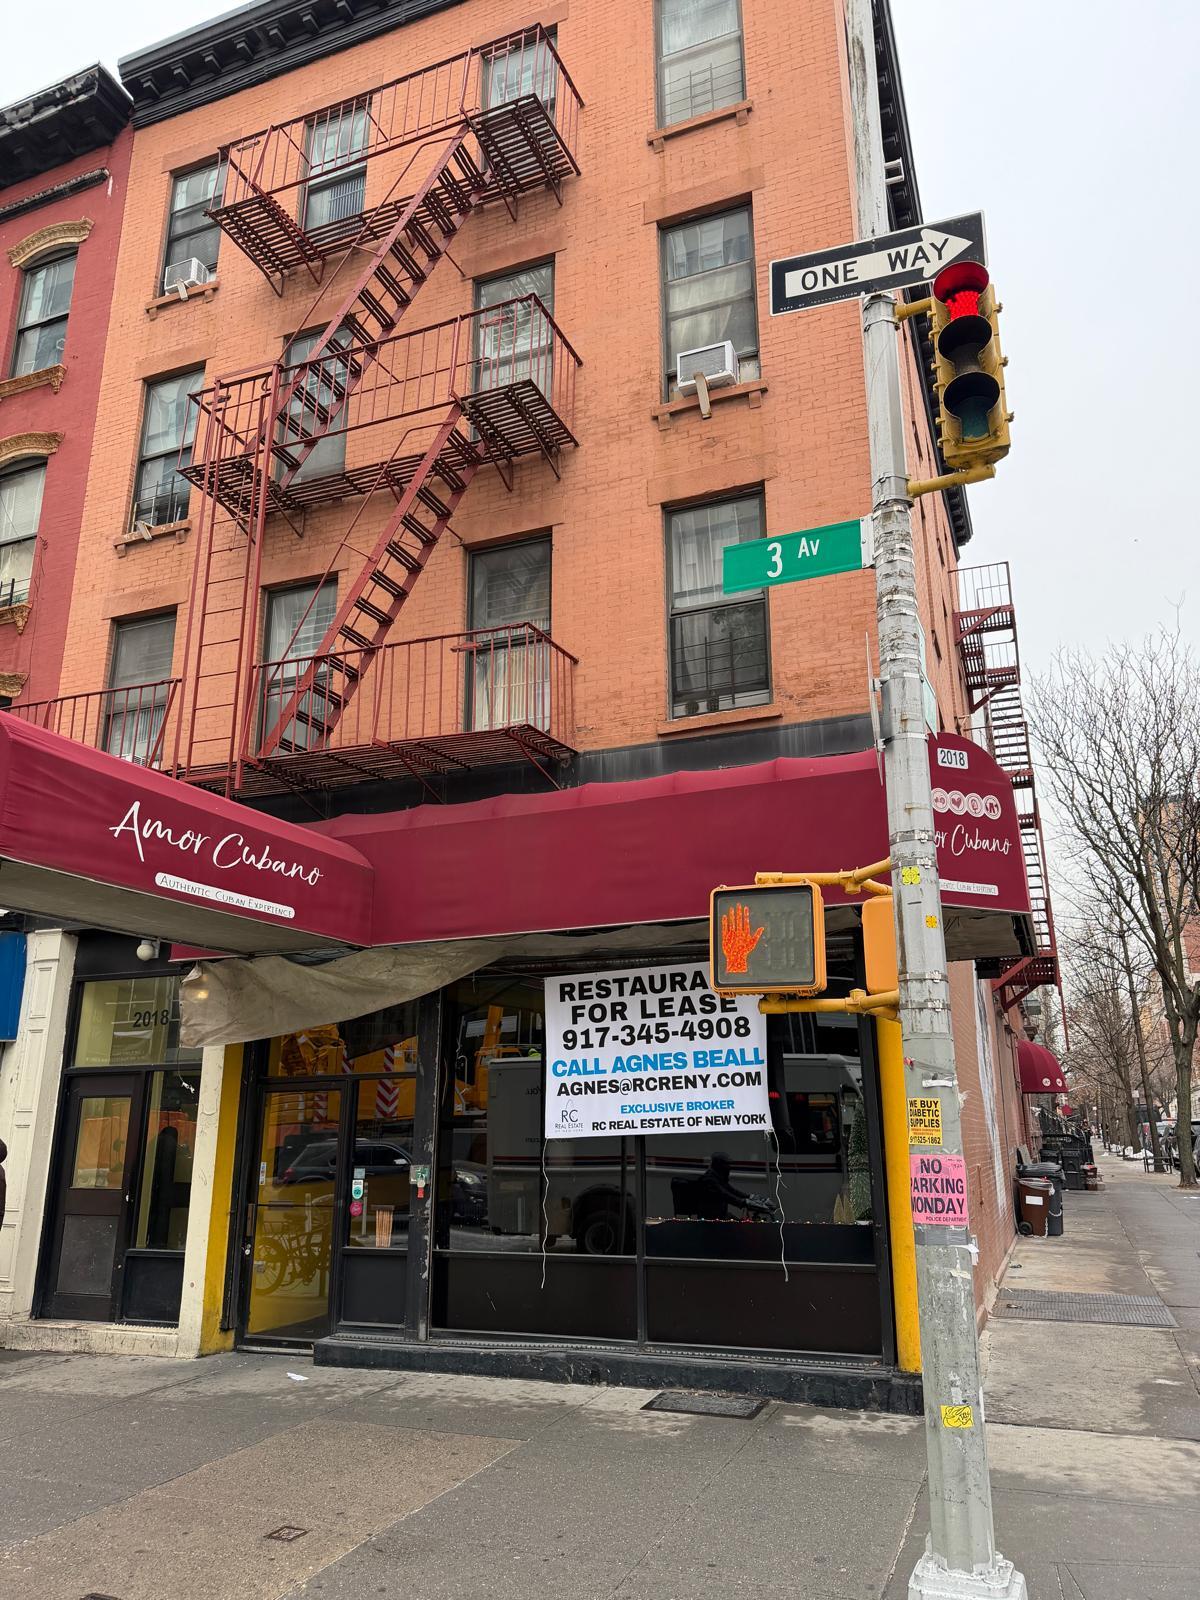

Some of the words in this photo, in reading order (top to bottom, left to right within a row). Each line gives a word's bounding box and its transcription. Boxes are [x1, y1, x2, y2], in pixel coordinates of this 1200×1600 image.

[801, 260, 859, 291] ONE
[888, 237, 949, 273] WAY
[766, 543, 782, 578] 3
[798, 537, 820, 559] Av
[940, 750, 966, 767] 2018
[109, 801, 210, 862] Amor
[213, 833, 324, 886] Cubano
[951, 824, 1013, 856] Cubano
[559, 970, 708, 1002] RESTAURA
[133, 1009, 169, 1029] 2018
[571, 1002, 628, 1025] FOR
[640, 994, 738, 1019] LEASE
[562, 1016, 751, 1050] 917-345-4908
[552, 1057, 607, 1078] CALL
[611, 1051, 688, 1074] AGNES
[693, 1047, 764, 1069] BEALL
[557, 1071, 762, 1096] AGNES@RCRENY.COM
[620, 1101, 684, 1115] EXCLUSIVE
[686, 1100, 735, 1112] BROKER
[909, 1100, 917, 1108] WE
[920, 1100, 938, 1108] BUY
[910, 1109, 939, 1118] DIABETIC
[561, 1109, 578, 1123] RC
[592, 1121, 607, 1131] RC
[609, 1119, 638, 1130] REAL
[640, 1117, 684, 1129] ESTATE
[686, 1116, 702, 1127] OF
[705, 1115, 732, 1126] NEW
[733, 1113, 767, 1125] YORK
[911, 1118, 940, 1128] SUPPLIES
[920, 1159, 942, 1174] NO
[911, 1177, 964, 1194] ARKING
